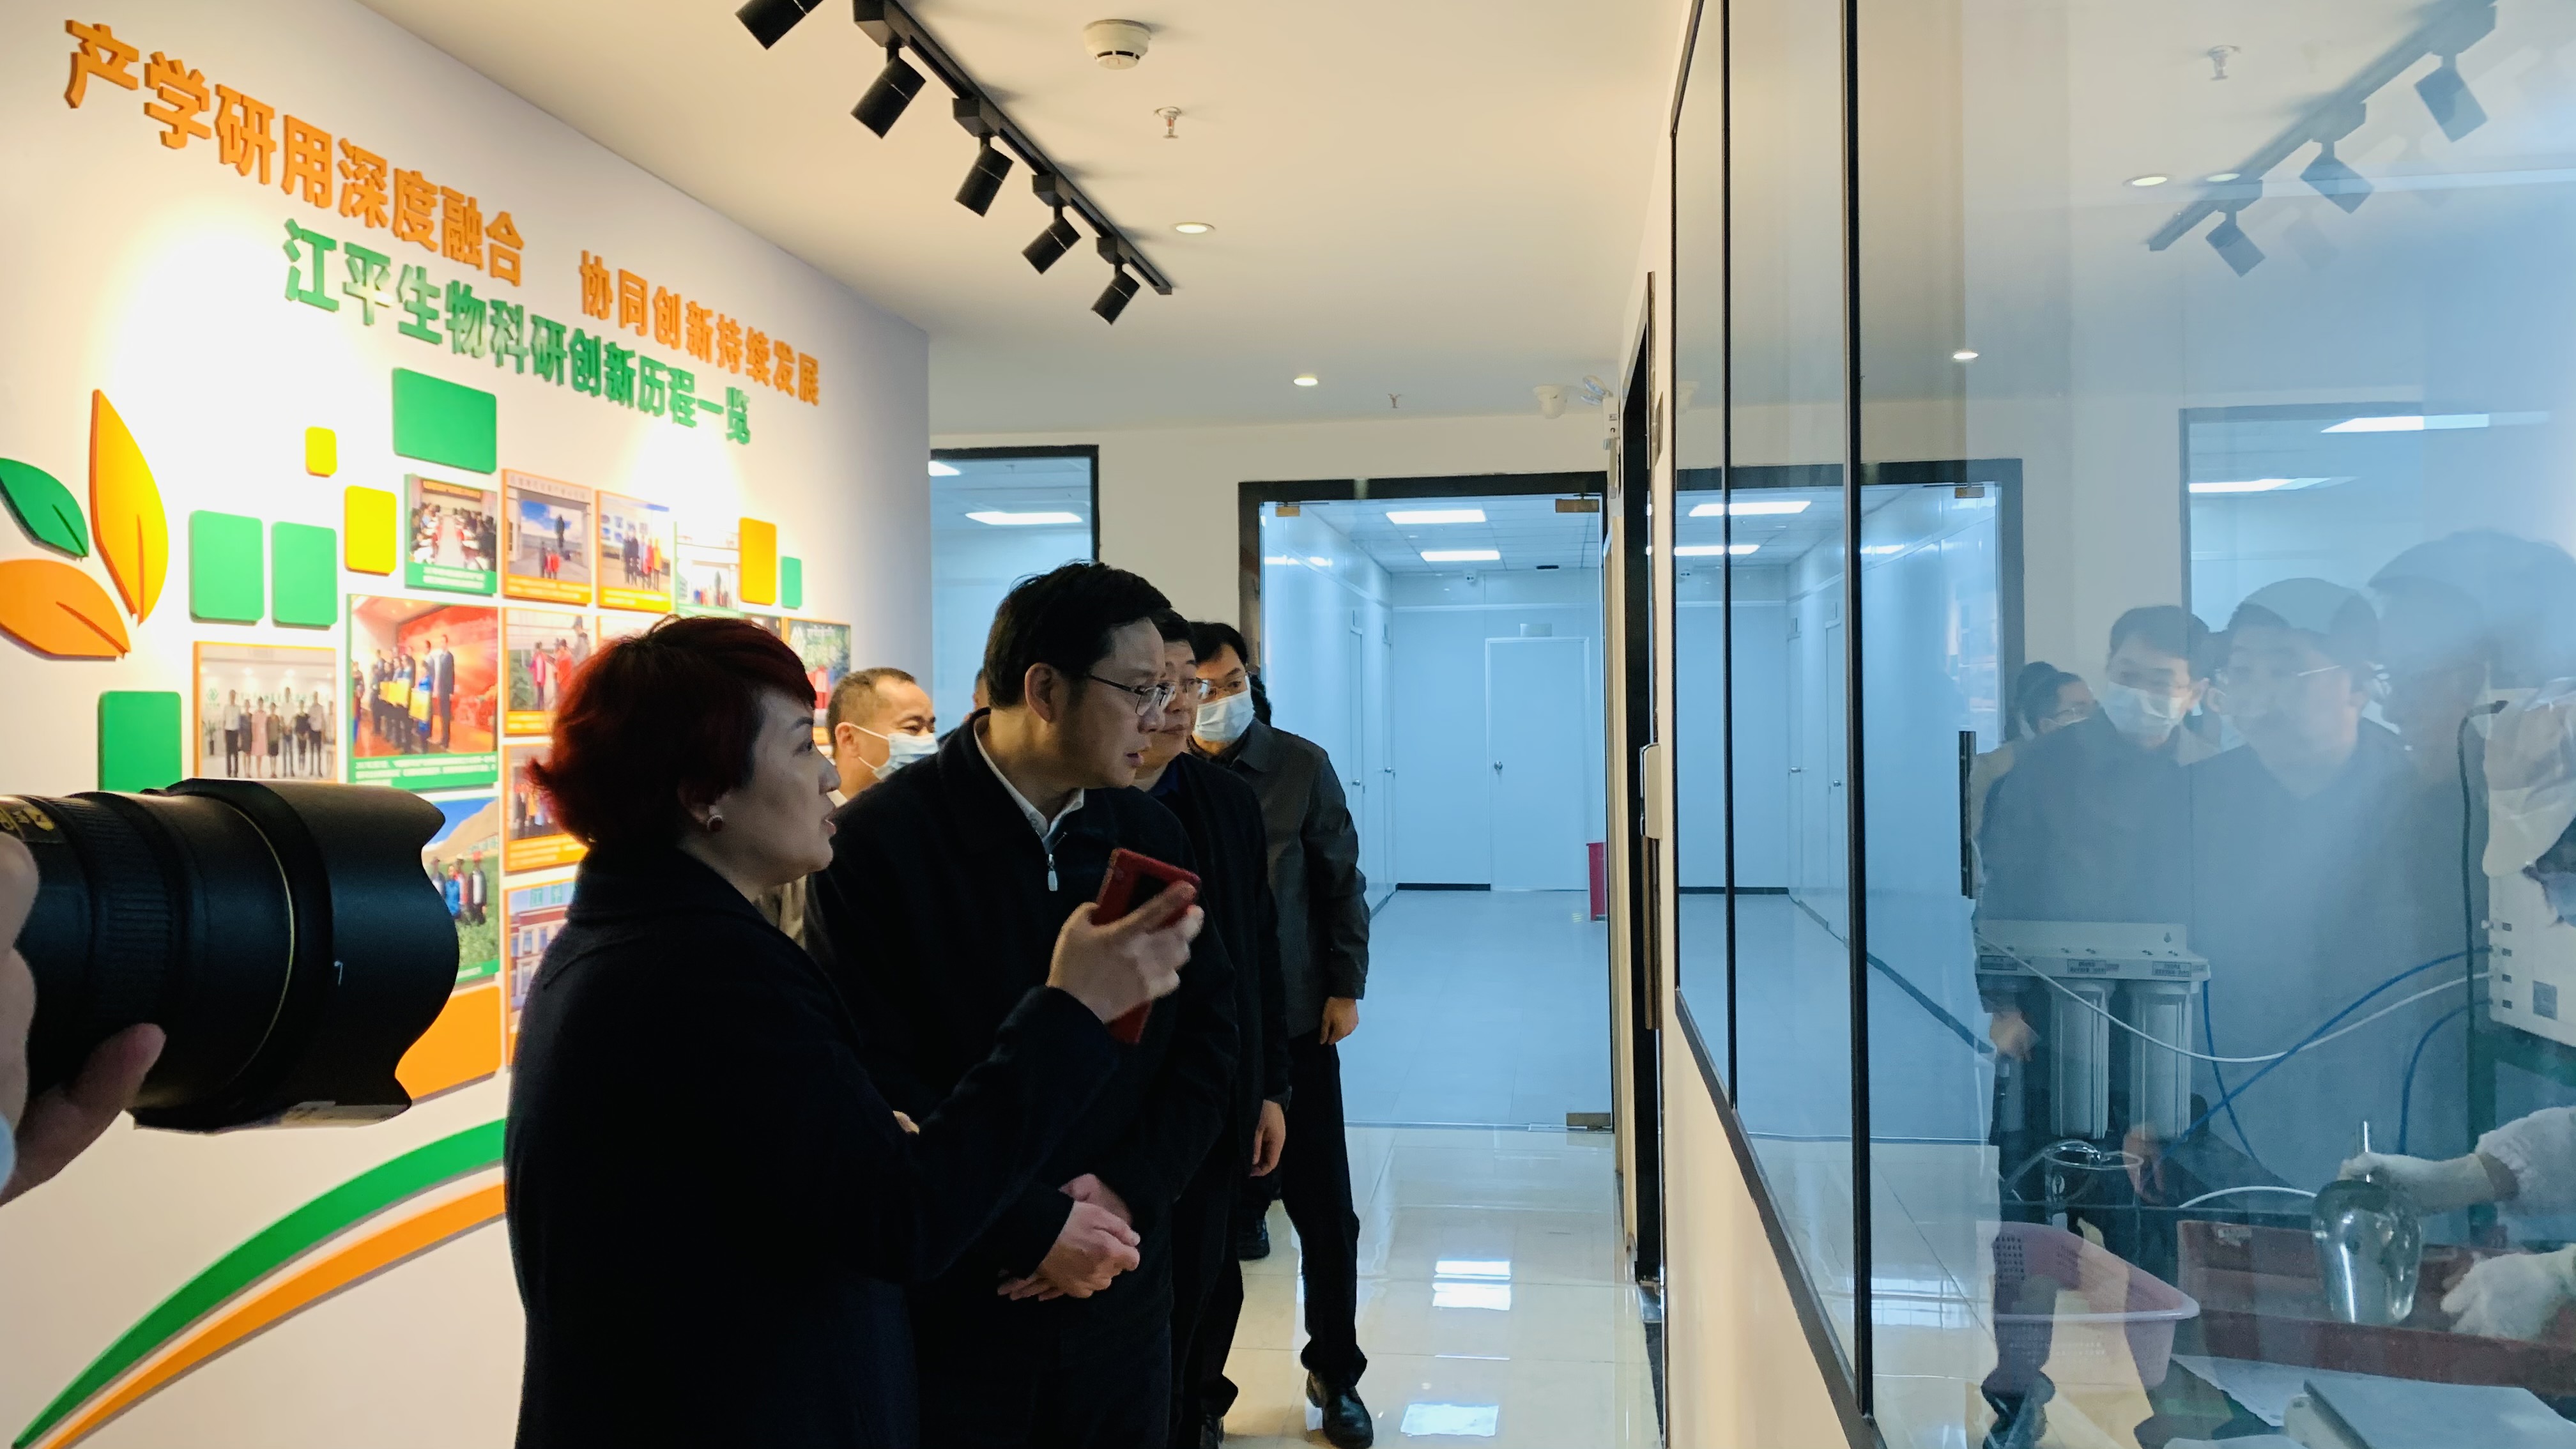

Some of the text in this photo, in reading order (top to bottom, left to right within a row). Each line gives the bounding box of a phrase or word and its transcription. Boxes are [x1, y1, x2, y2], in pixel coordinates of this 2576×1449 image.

[63, 19, 820, 406] 产学研用深度融合 协同创新持续发展
[284, 218, 751, 445] 江平生物科研创新历程一览
